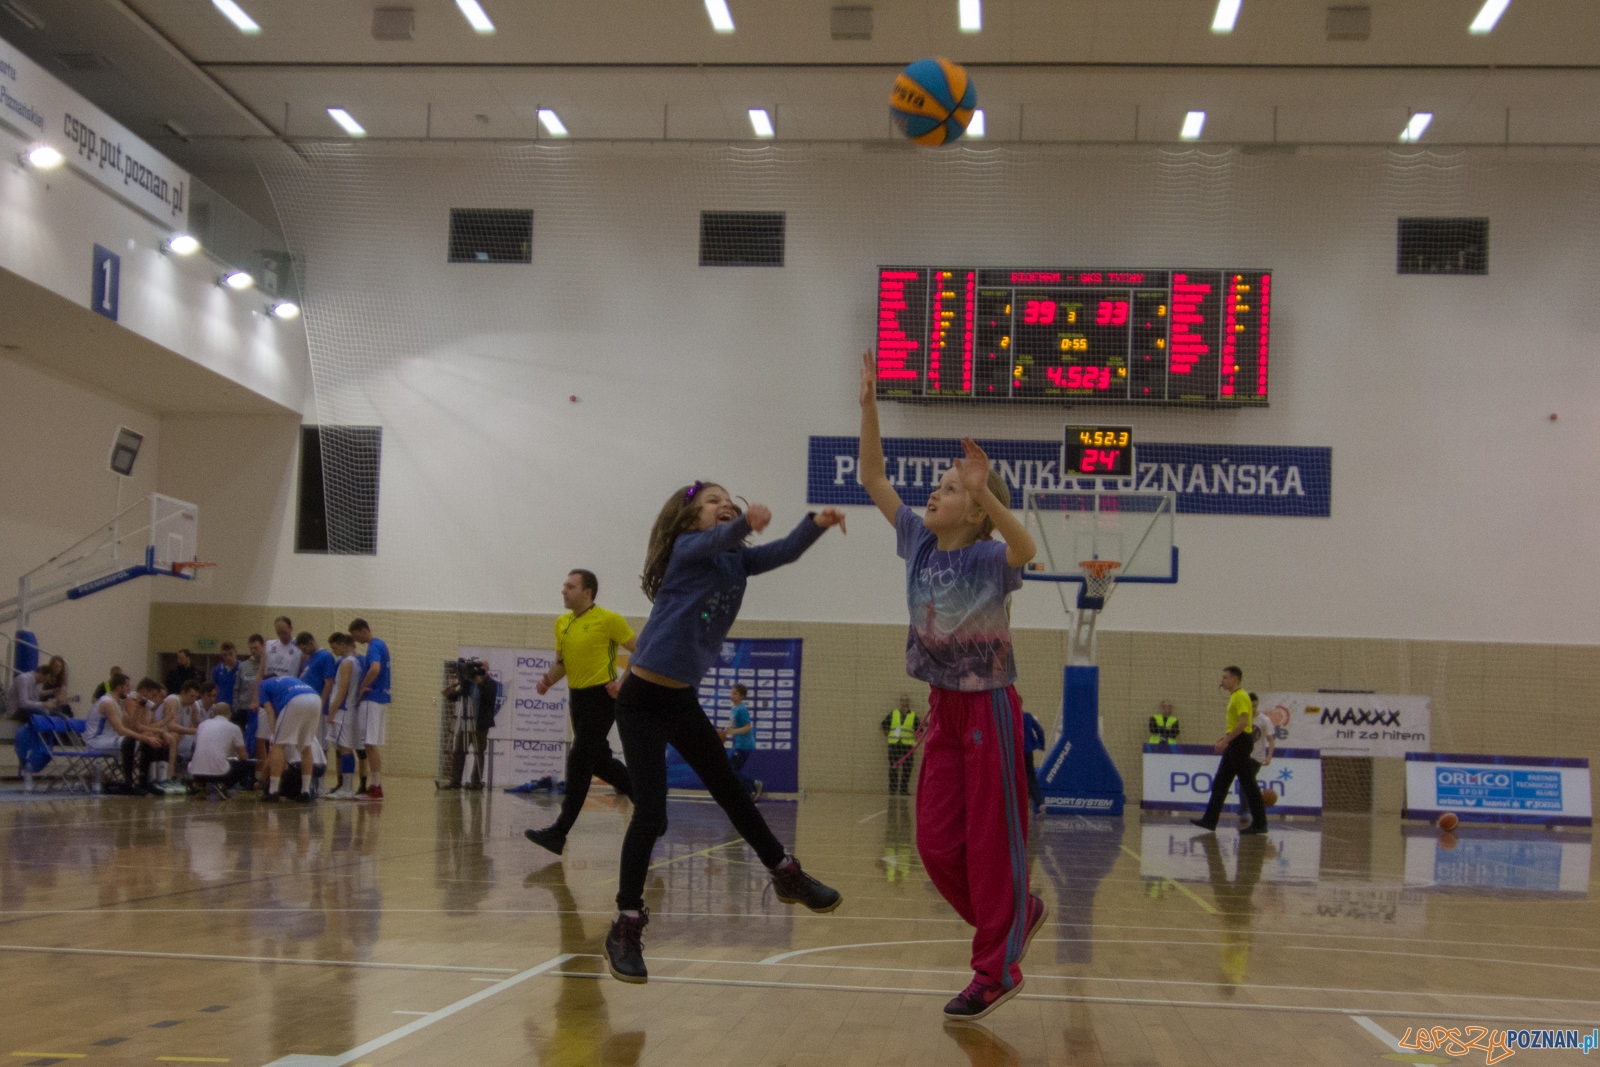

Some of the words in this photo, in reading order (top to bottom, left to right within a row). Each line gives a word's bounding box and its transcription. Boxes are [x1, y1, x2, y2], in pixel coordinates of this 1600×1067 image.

[63, 112, 183, 216] cspp.put.poznan.pl
[102, 258, 111, 310] 1
[1024, 300, 1057, 325] 39
[1067, 311, 1077, 324] 3
[1096, 301, 1129, 325] 33
[1157, 304, 1167, 317] 3
[1000, 336, 1011, 349] 2
[1060, 337, 1088, 351] 0:55
[1080, 431, 1129, 446] 4.52.3
[1095, 458, 1304, 495] ZNAŃSKA
[1320, 707, 1401, 727] MAXXX
[1336, 729, 1357, 739] hit
[1359, 731, 1379, 739] za
[1382, 730, 1425, 741] hitem
[1044, 797, 1113, 808] SPORTSYSTEM
